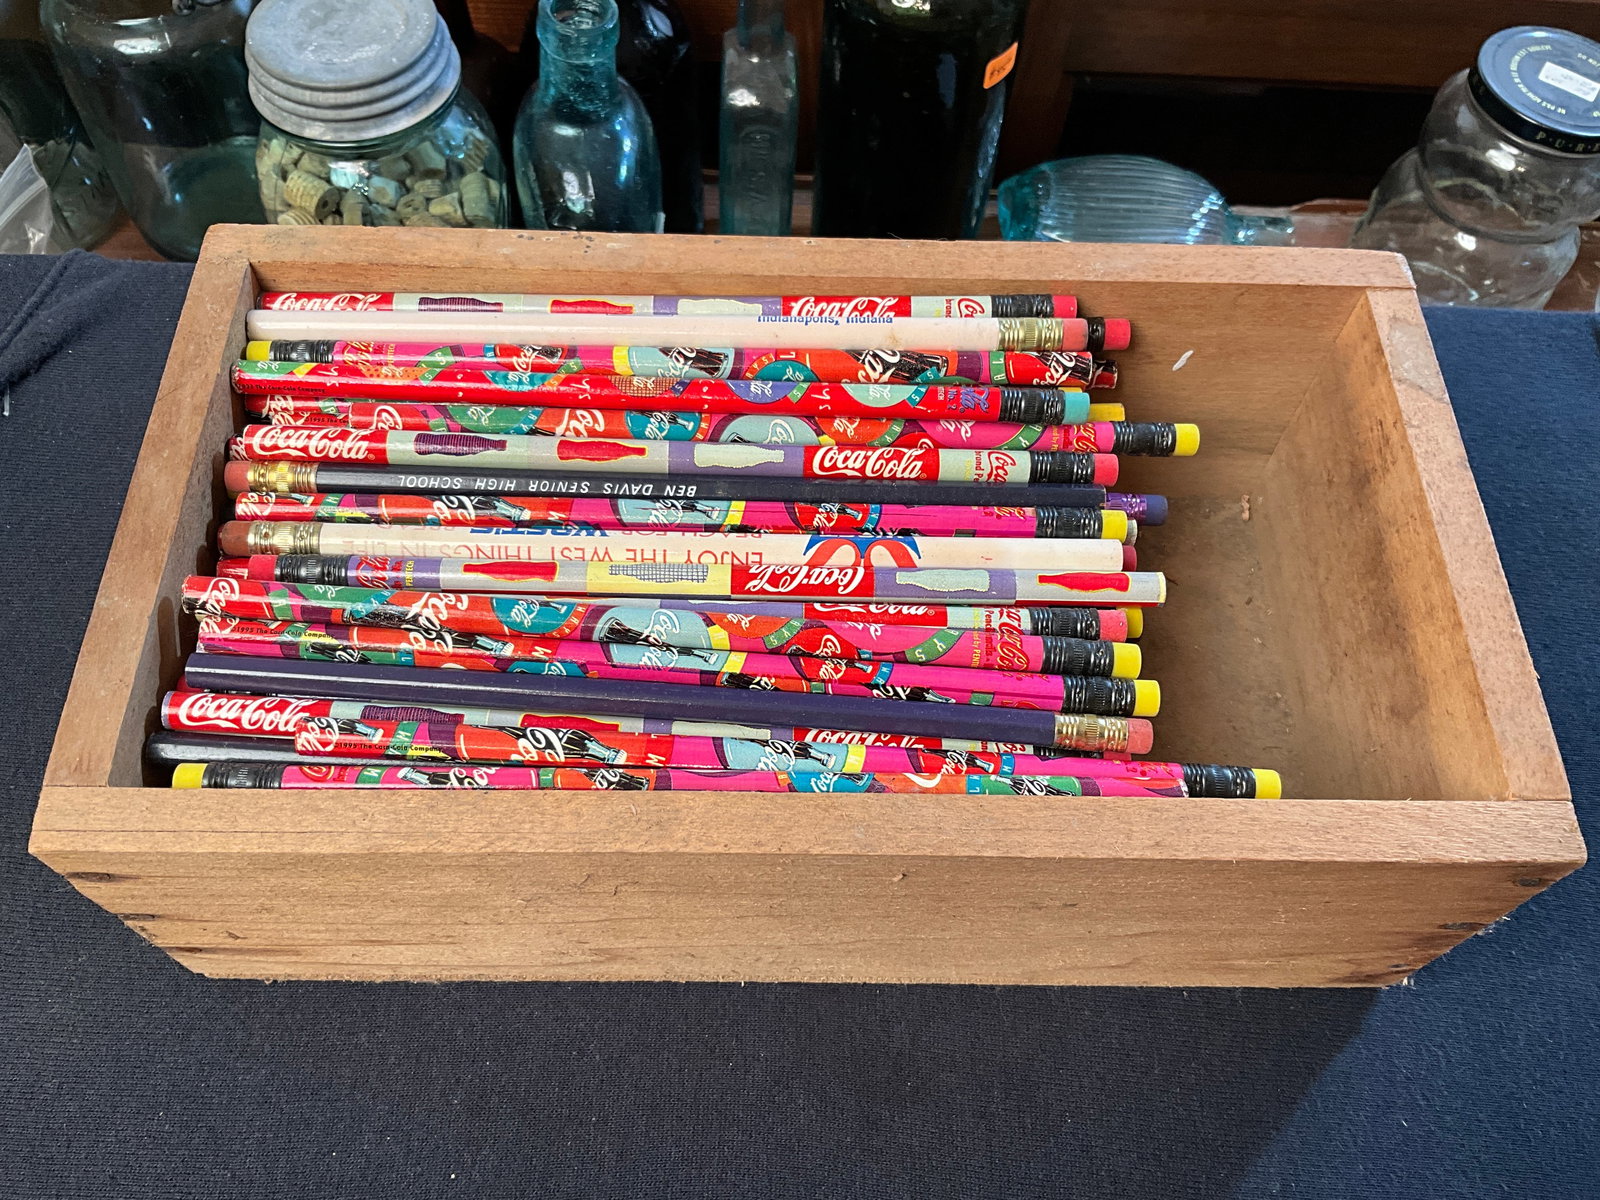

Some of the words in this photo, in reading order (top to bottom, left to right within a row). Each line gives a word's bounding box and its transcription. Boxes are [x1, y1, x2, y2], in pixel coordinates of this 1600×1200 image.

[252, 425, 376, 459] Coca-Cola
[812, 446, 925, 478] Coca-Cola
[399, 475, 462, 489] SCHOOL
[475, 478, 516, 491] HIGH
[528, 480, 590, 493] SENIOR
[603, 483, 653, 496] DAVIS
[664, 485, 697, 497] BEN
[551, 546, 613, 562] WEST
[625, 548, 667, 563] THE
[684, 550, 763, 566] ENJOY
[745, 564, 865, 594] Coca-Cola
[178, 693, 319, 732] Coca-Cola
[410, 745, 443, 753] Company
